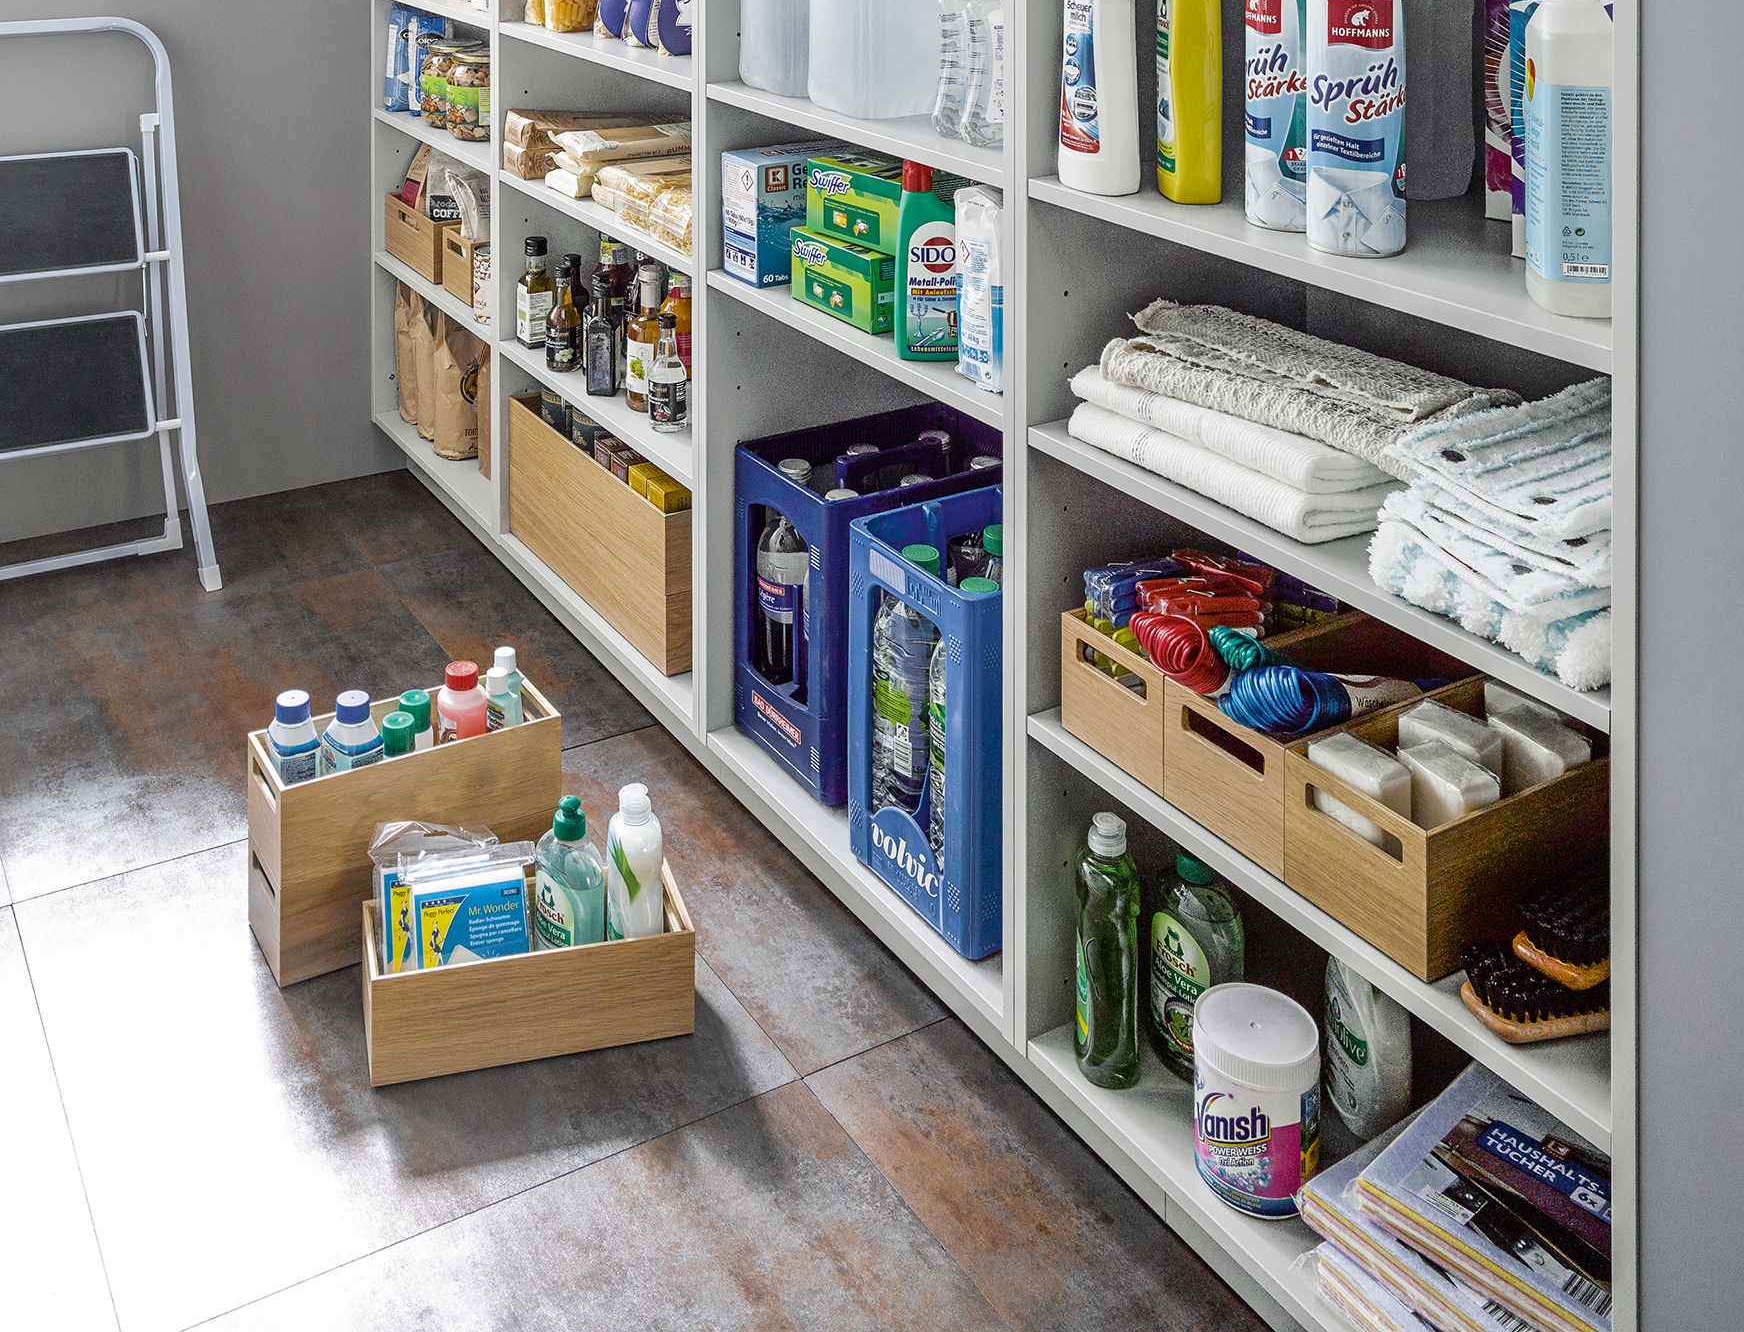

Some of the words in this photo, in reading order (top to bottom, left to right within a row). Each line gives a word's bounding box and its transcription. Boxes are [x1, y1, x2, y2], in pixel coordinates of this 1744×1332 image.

[1067, 0, 1091, 13] Scheuer
[1070, 11, 1086, 22] milch
[1331, 26, 1390, 38] HOFFMANNS
[1246, 43, 1288, 77] rüh
[1311, 57, 1397, 112] Sprüh
[1316, 141, 1339, 152] einzelner
[1340, 147, 1381, 158] Textilbereiche
[1345, 142, 1360, 150] Halt
[809, 170, 849, 194] Swiffer
[793, 192, 805, 200] mit
[794, 239, 827, 265] Swiffer
[910, 246, 956, 263] SIDO
[1562, 253, 1575, 262] 0,5
[763, 274, 774, 283] 60
[775, 274, 788, 282] Tabs
[754, 695, 765, 710] BAD
[765, 705, 799, 741] DÜRRHEIMER
[871, 822, 939, 898] volvic
[393, 889, 406, 897] Peggy
[423, 910, 437, 918] Peggy
[438, 907, 455, 915] Perfect
[468, 907, 482, 917] Mr.
[483, 901, 519, 914] Wonder
[468, 914, 511, 925] Radier-Schwamm
[469, 923, 487, 933] Éponge
[496, 919, 520, 929] gommage
[470, 932, 488, 941] Spugna
[489, 930, 497, 938] per
[498, 926, 522, 935] cancellare
[548, 923, 565, 940] Vera
[486, 936, 504, 945] sponge
[1156, 938, 1196, 978] Frosch
[1174, 974, 1198, 996] Vera
[1197, 1095, 1270, 1143] Vanish
[1208, 1144, 1236, 1157] POWER
[1238, 1143, 1268, 1157] WEISS
[1219, 1157, 1230, 1166] Oxi
[1231, 1157, 1254, 1167] Action
[1486, 1136, 1557, 1183] TÜCHER
[1491, 1128, 1606, 1196] HAUSHALTS-
[1577, 1190, 1598, 1209] 6x
